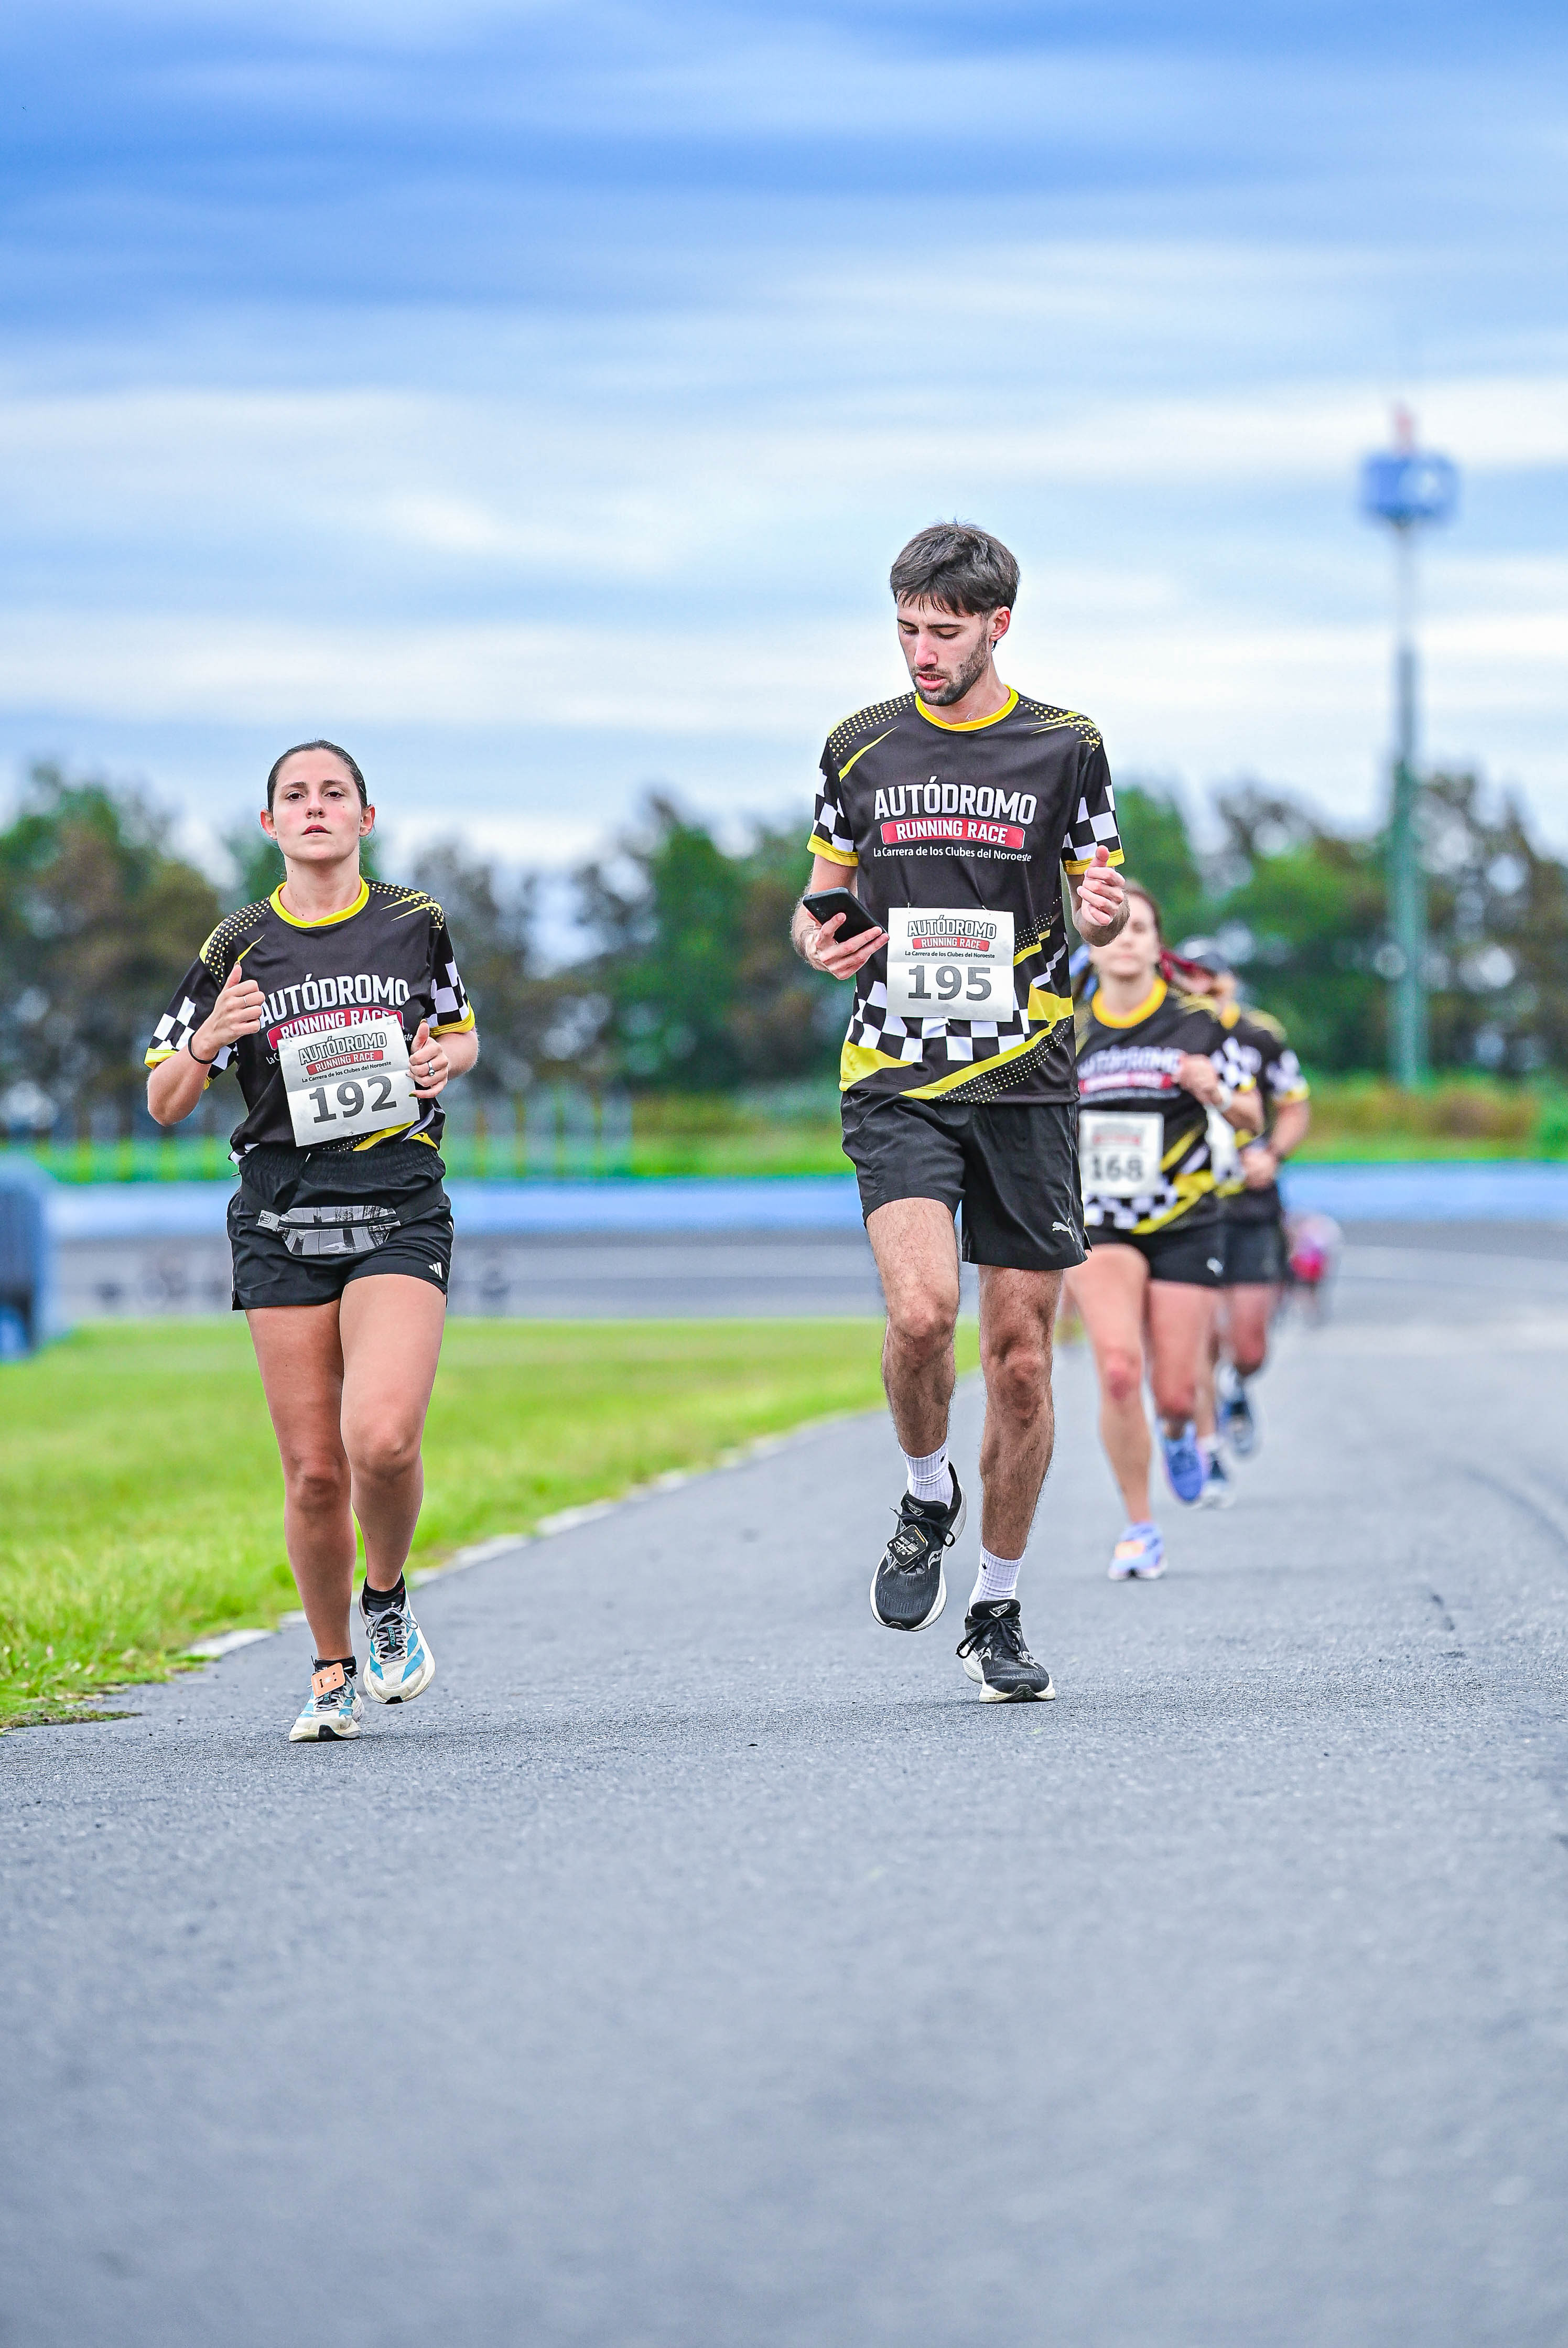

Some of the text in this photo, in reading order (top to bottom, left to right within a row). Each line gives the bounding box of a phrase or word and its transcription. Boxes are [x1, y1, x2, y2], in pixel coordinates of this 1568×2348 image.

[874, 776, 1037, 825] AUTÓDROMO
[895, 820, 1008, 844] RUNNING RACE
[873, 846, 1032, 861] La Carrera de los Clubes del Noroeste
[907, 914, 997, 939] AUTÓDROMO
[921, 937, 981, 949] RUNNING RACE
[908, 965, 992, 1001] 195
[259, 973, 410, 1029] AUTÓDROMO
[280, 1011, 345, 1039] RUNNING
[298, 1032, 387, 1065] AUTÓDROMO
[315, 1052, 375, 1072] RUNNING RACE
[343, 1067, 360, 1075] Clubes
[370, 1061, 392, 1069] Noroeste
[309, 1075, 397, 1124] 192
